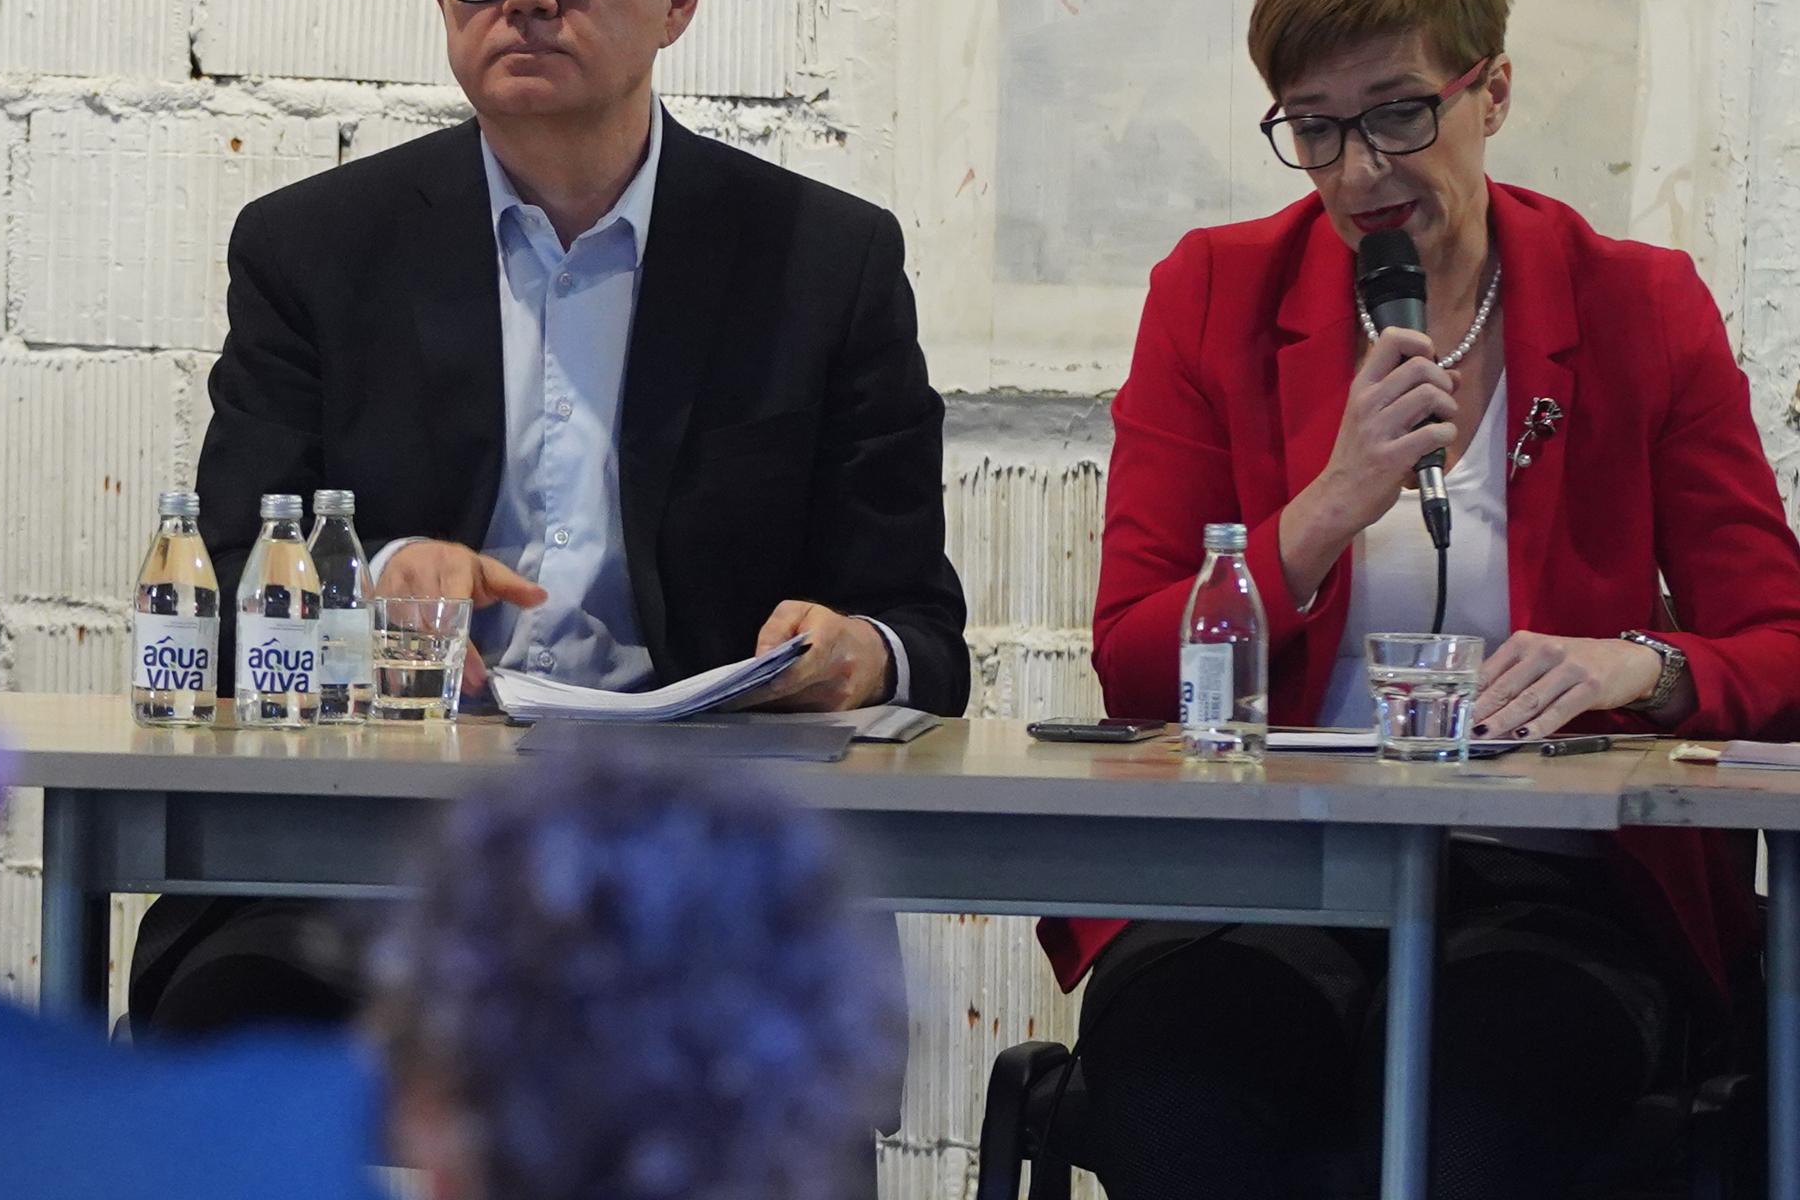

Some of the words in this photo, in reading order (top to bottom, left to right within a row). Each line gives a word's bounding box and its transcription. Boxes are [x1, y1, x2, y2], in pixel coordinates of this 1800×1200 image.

[143, 645, 209, 670] aqua
[248, 647, 314, 672] aqua
[147, 668, 204, 691] viva
[252, 670, 309, 693] viva
